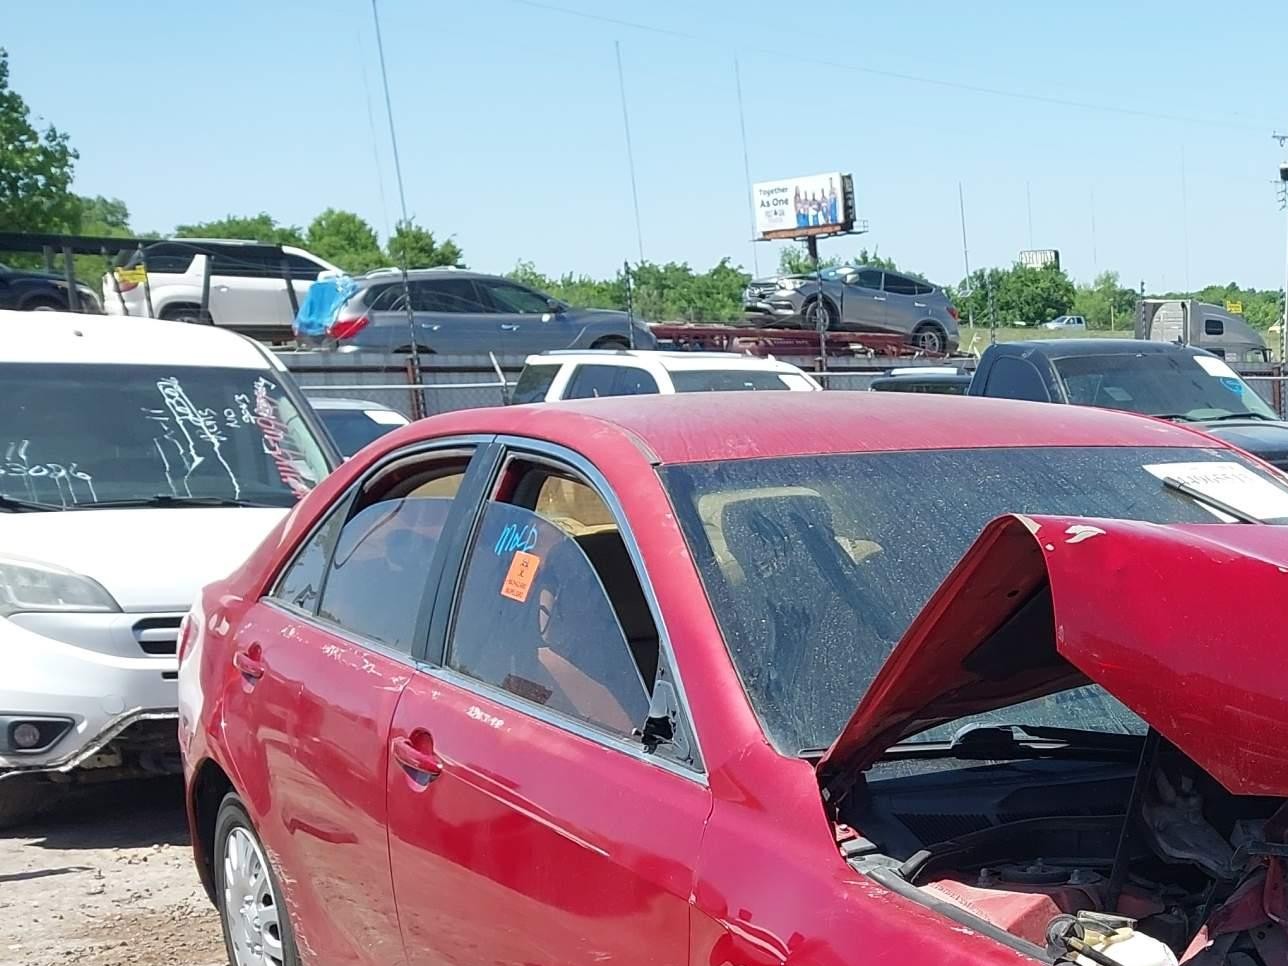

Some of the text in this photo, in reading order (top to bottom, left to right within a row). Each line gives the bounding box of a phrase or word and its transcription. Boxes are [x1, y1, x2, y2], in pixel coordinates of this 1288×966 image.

[759, 187, 788, 197] Together
[760, 198, 789, 208] As One
